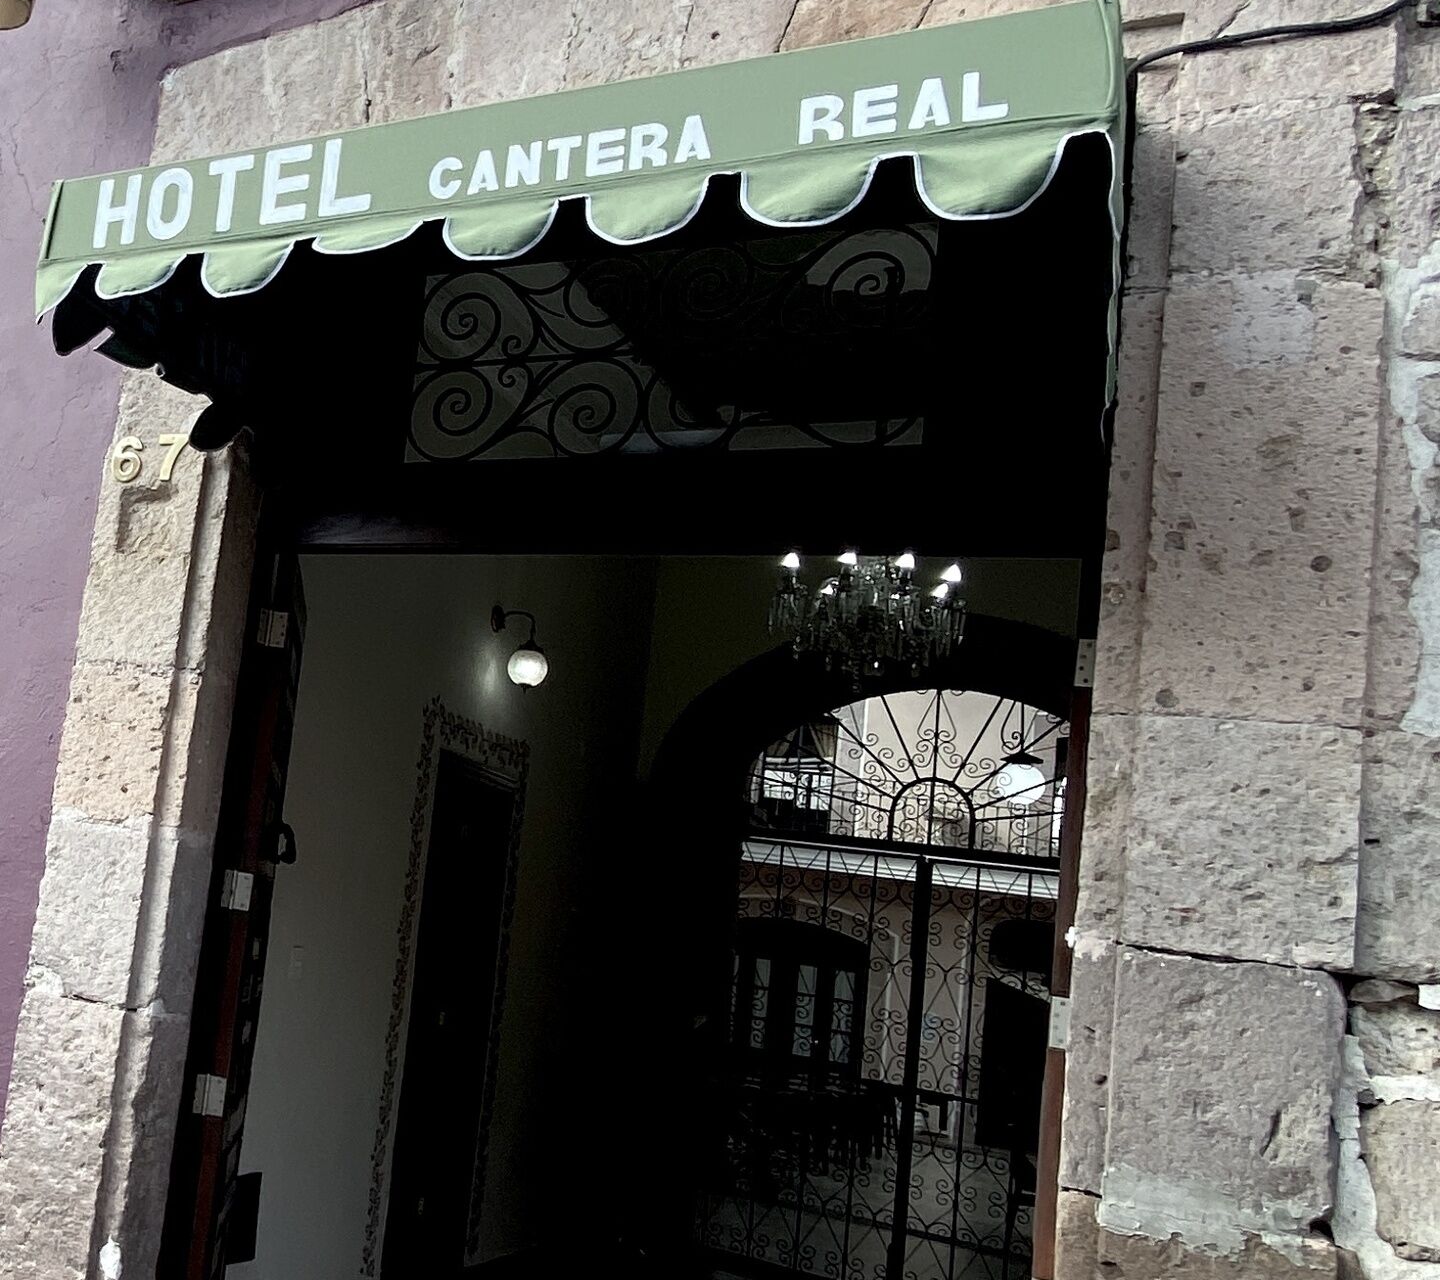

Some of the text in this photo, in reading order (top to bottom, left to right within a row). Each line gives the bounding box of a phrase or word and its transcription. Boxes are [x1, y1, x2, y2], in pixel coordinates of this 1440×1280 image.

[91, 71, 1009, 249] HOTEL CANTERA REAL
[111, 433, 190, 482] 67
